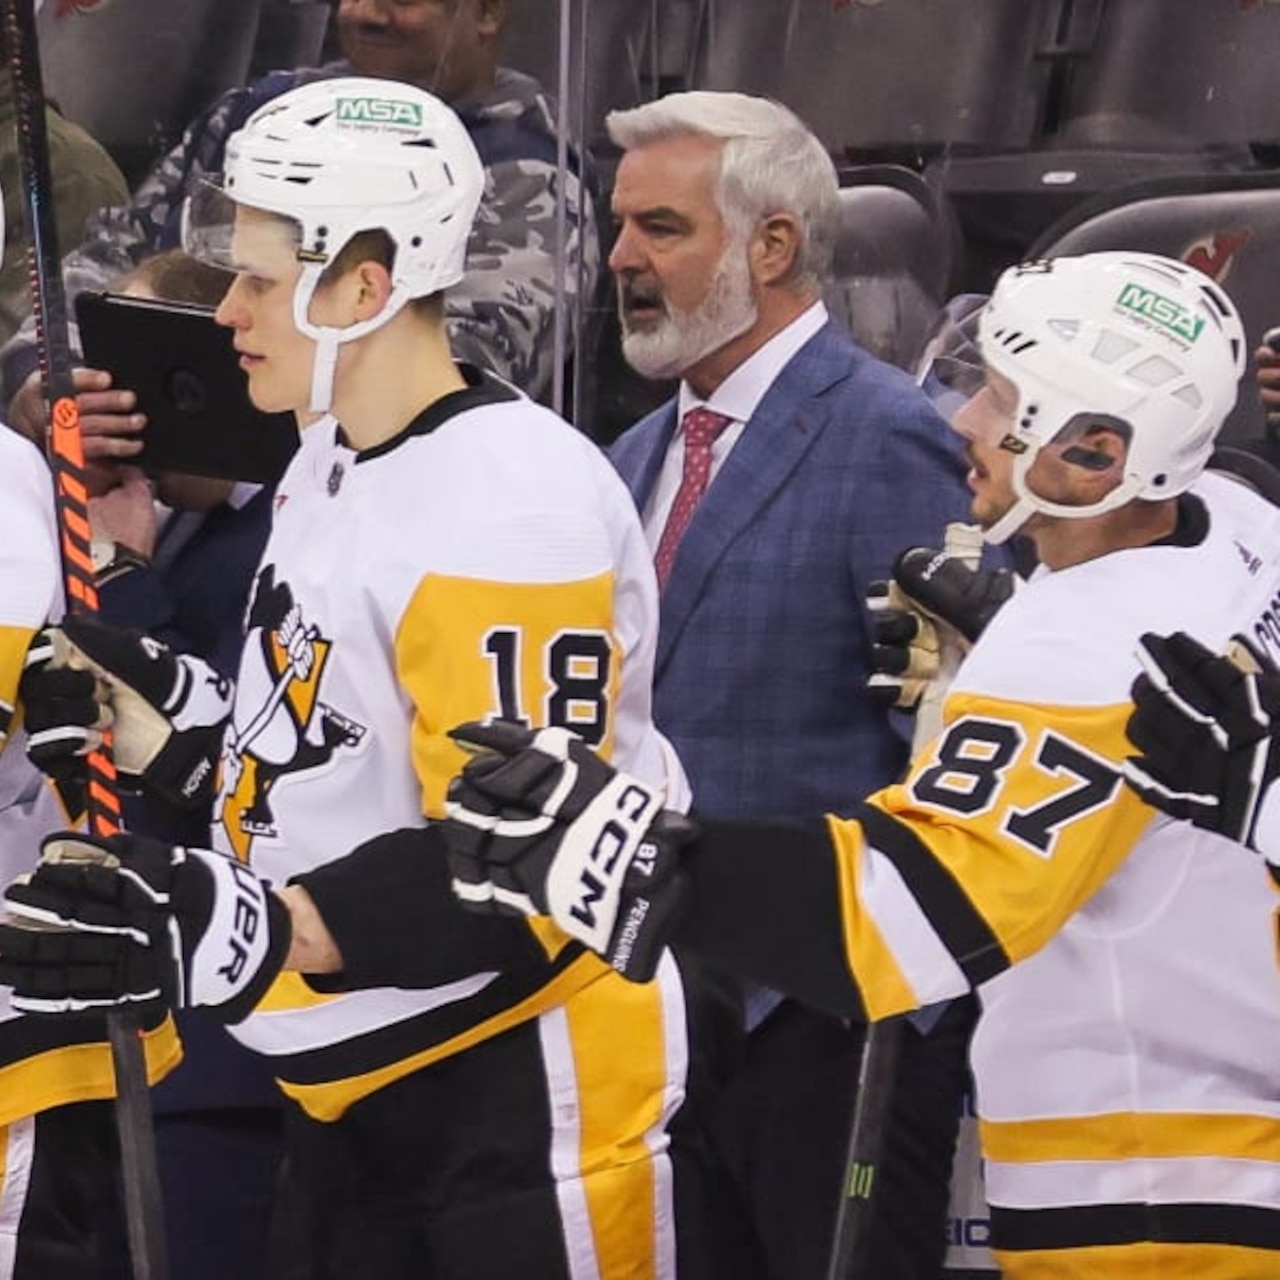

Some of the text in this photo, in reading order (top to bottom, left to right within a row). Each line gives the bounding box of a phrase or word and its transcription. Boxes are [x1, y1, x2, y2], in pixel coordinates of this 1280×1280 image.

[339, 99, 420, 124] MSA
[1120, 285, 1197, 340] MSA
[480, 624, 614, 750] 18
[907, 713, 1128, 860] 87
[567, 784, 651, 930] CCM
[632, 843, 658, 877] 87
[611, 897, 651, 974] PENGUINS
